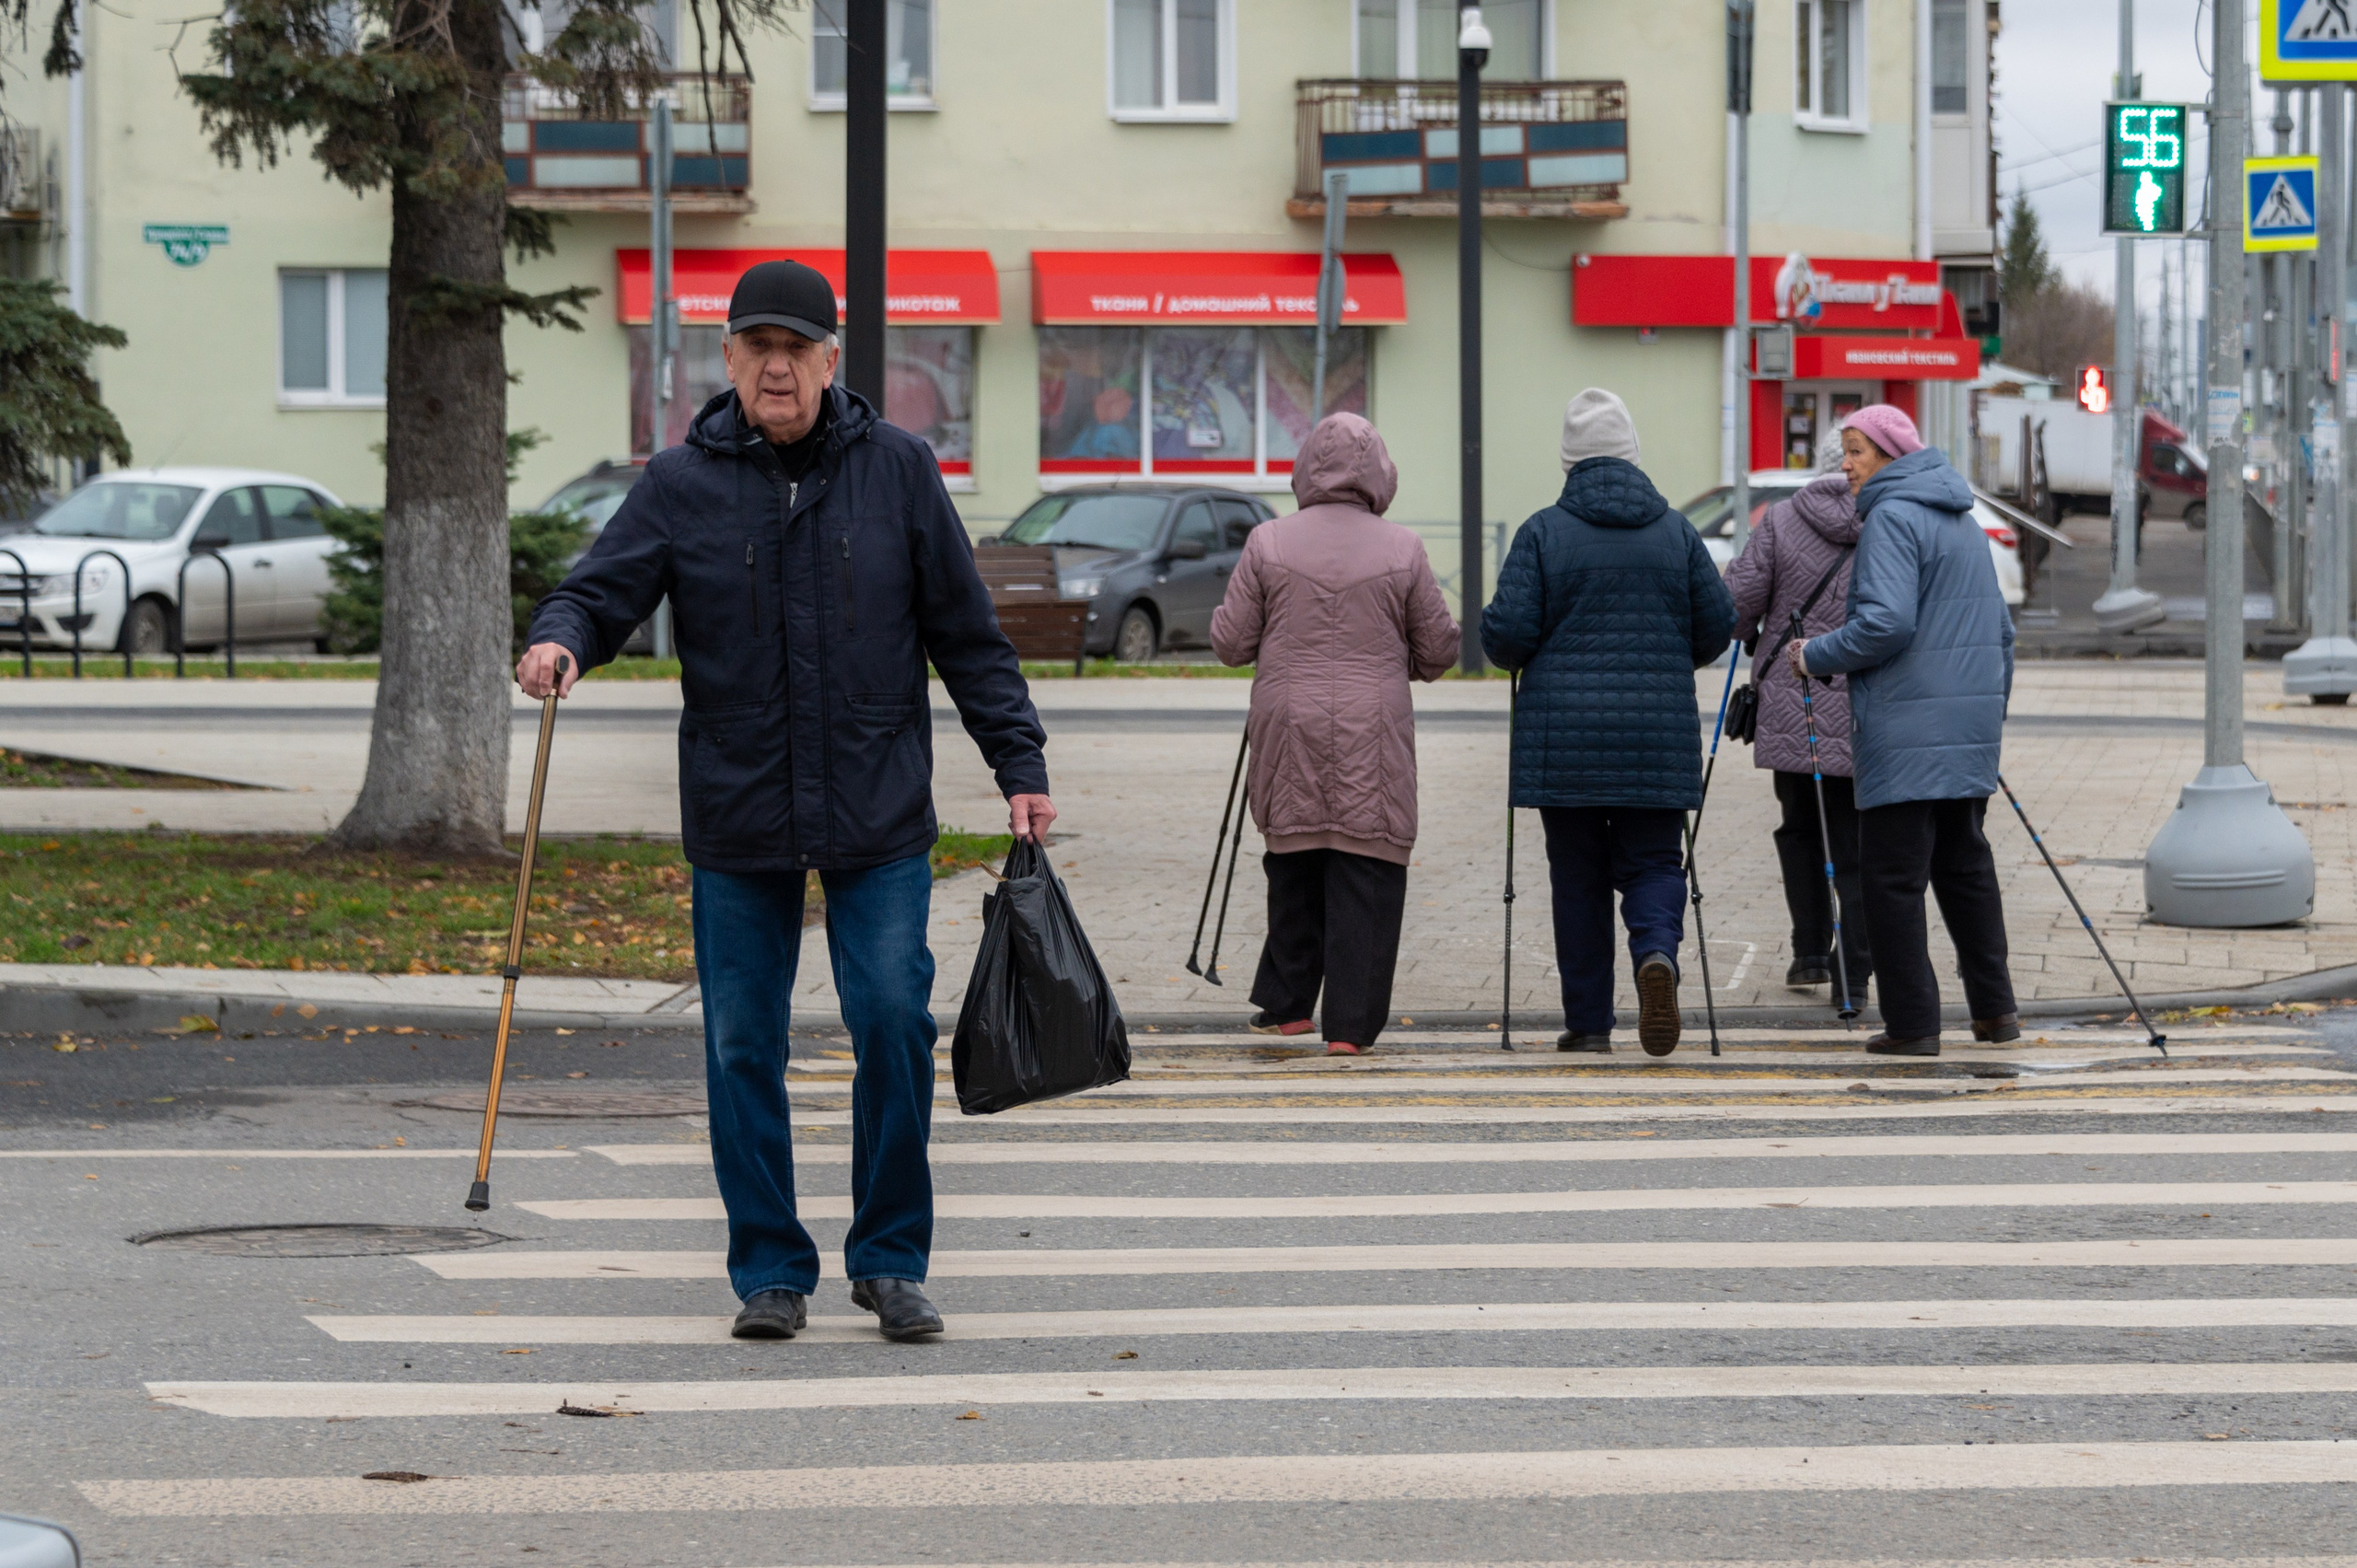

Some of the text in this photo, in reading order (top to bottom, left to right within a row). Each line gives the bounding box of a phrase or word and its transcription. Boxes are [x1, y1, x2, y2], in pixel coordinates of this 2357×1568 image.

[2120, 109, 2179, 168] 56
[679, 295, 961, 312] етск икотаж
[1089, 292, 1360, 313] ткани / домашний тексь
